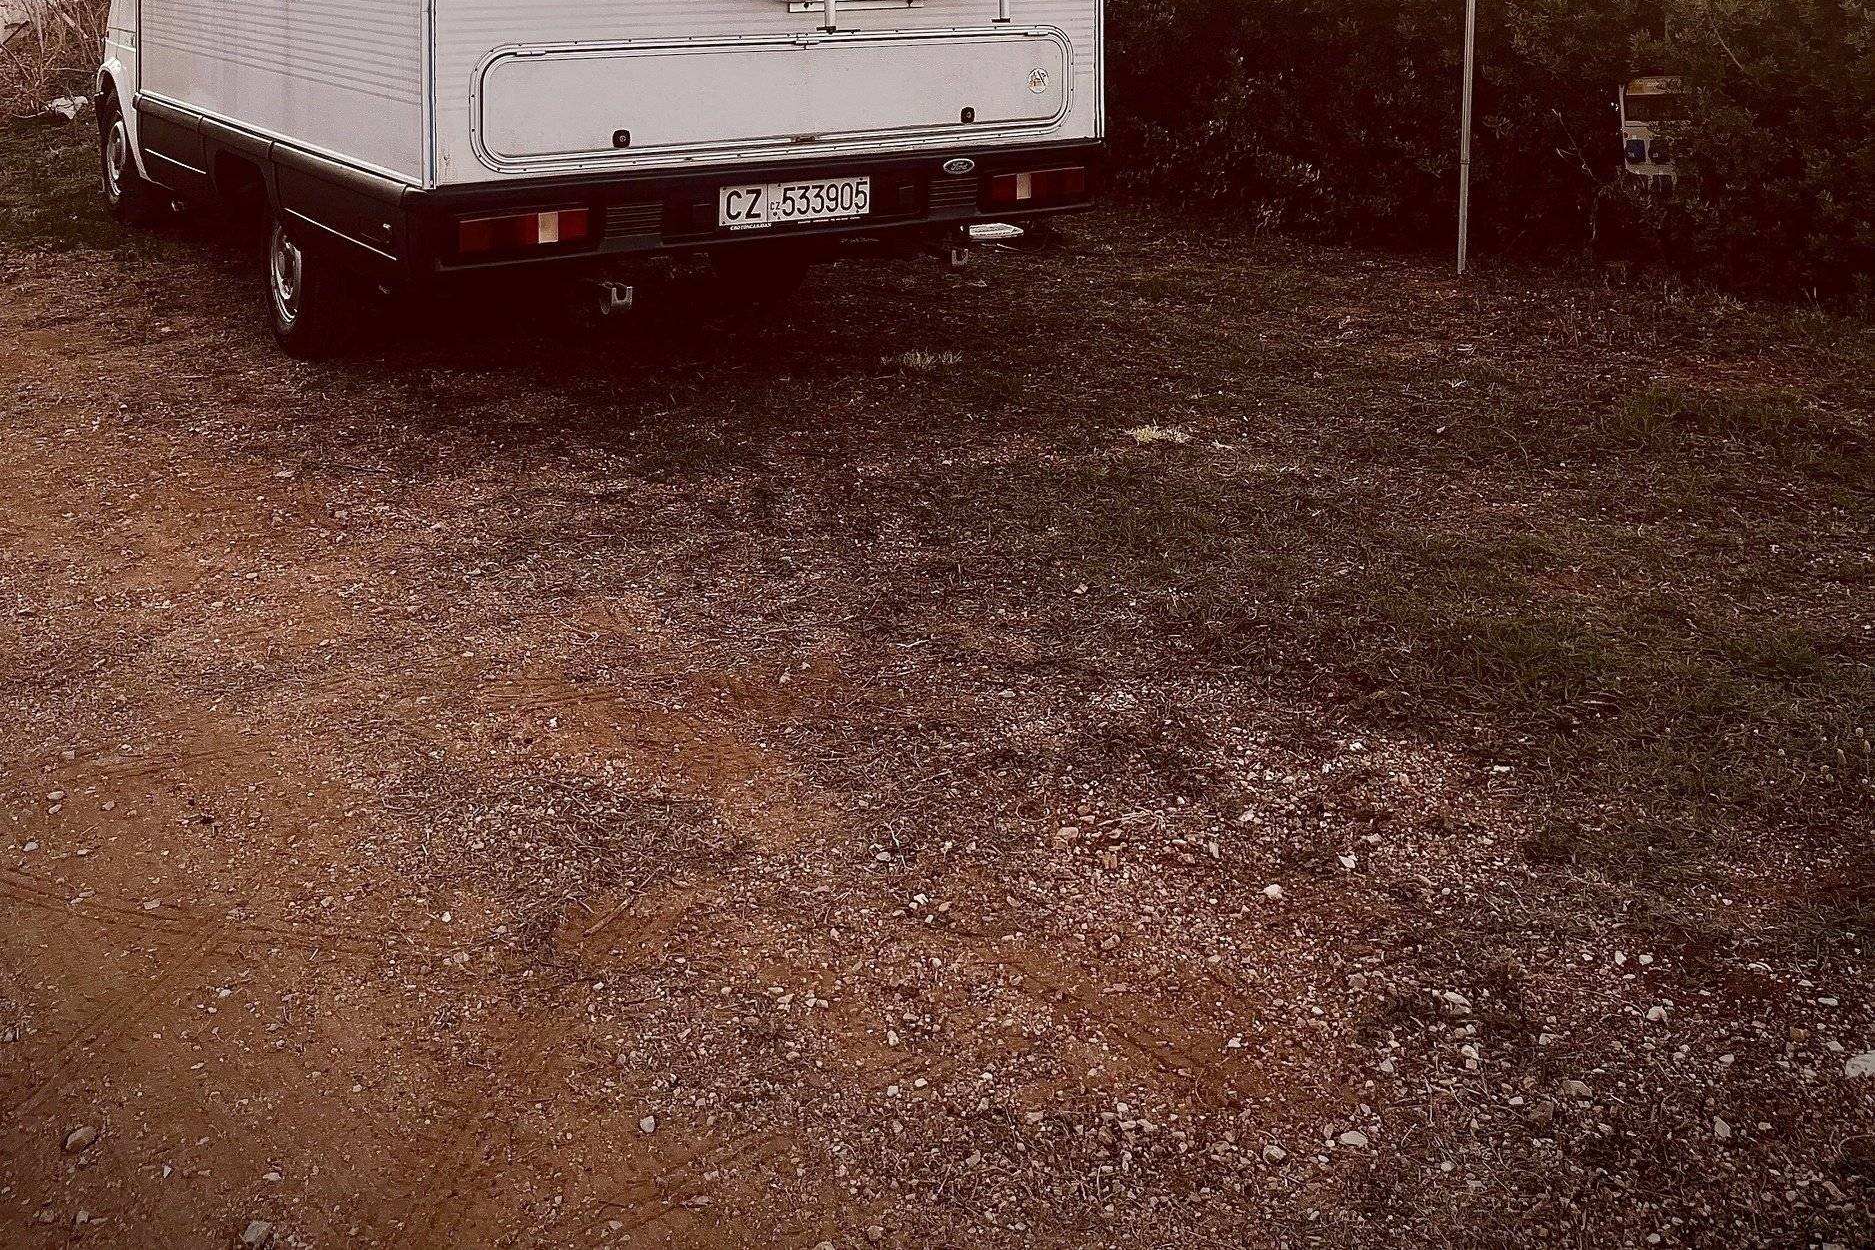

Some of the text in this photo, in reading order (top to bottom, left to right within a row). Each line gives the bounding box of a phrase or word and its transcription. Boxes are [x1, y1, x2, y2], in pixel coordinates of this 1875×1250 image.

[948, 159, 970, 171] Ford
[726, 180, 868, 221] CZ CZ 533905
